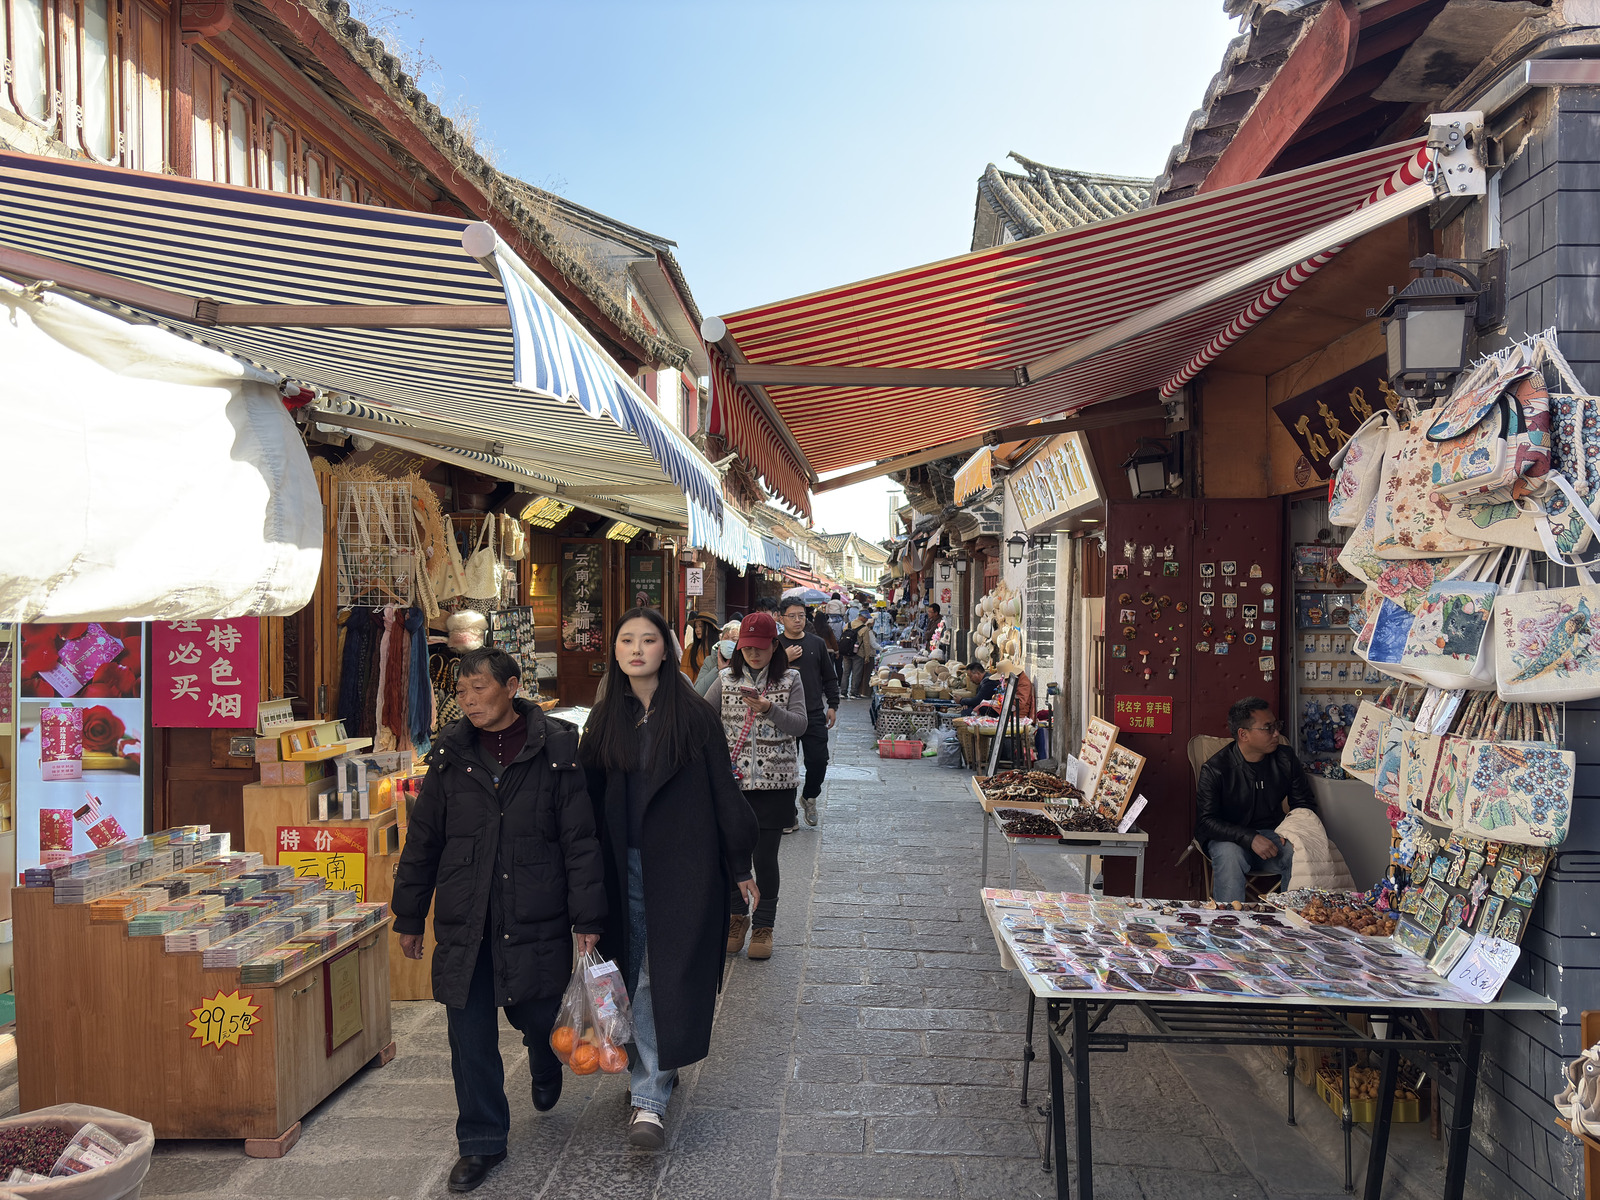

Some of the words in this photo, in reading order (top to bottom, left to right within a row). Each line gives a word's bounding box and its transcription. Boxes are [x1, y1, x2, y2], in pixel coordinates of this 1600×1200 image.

[689, 571, 701, 584] 茶
[575, 553, 590, 646] 云南小粒咖啡
[206, 624, 242, 719] 特色烟
[1117, 701, 1141, 713] 找名字
[1146, 702, 1171, 714] 穿手链
[1129, 716, 1155, 728] 3元/颗
[280, 829, 334, 851] 特价
[335, 829, 352, 845] Special
[350, 841, 365, 852] price
[297, 852, 346, 879] 云南
